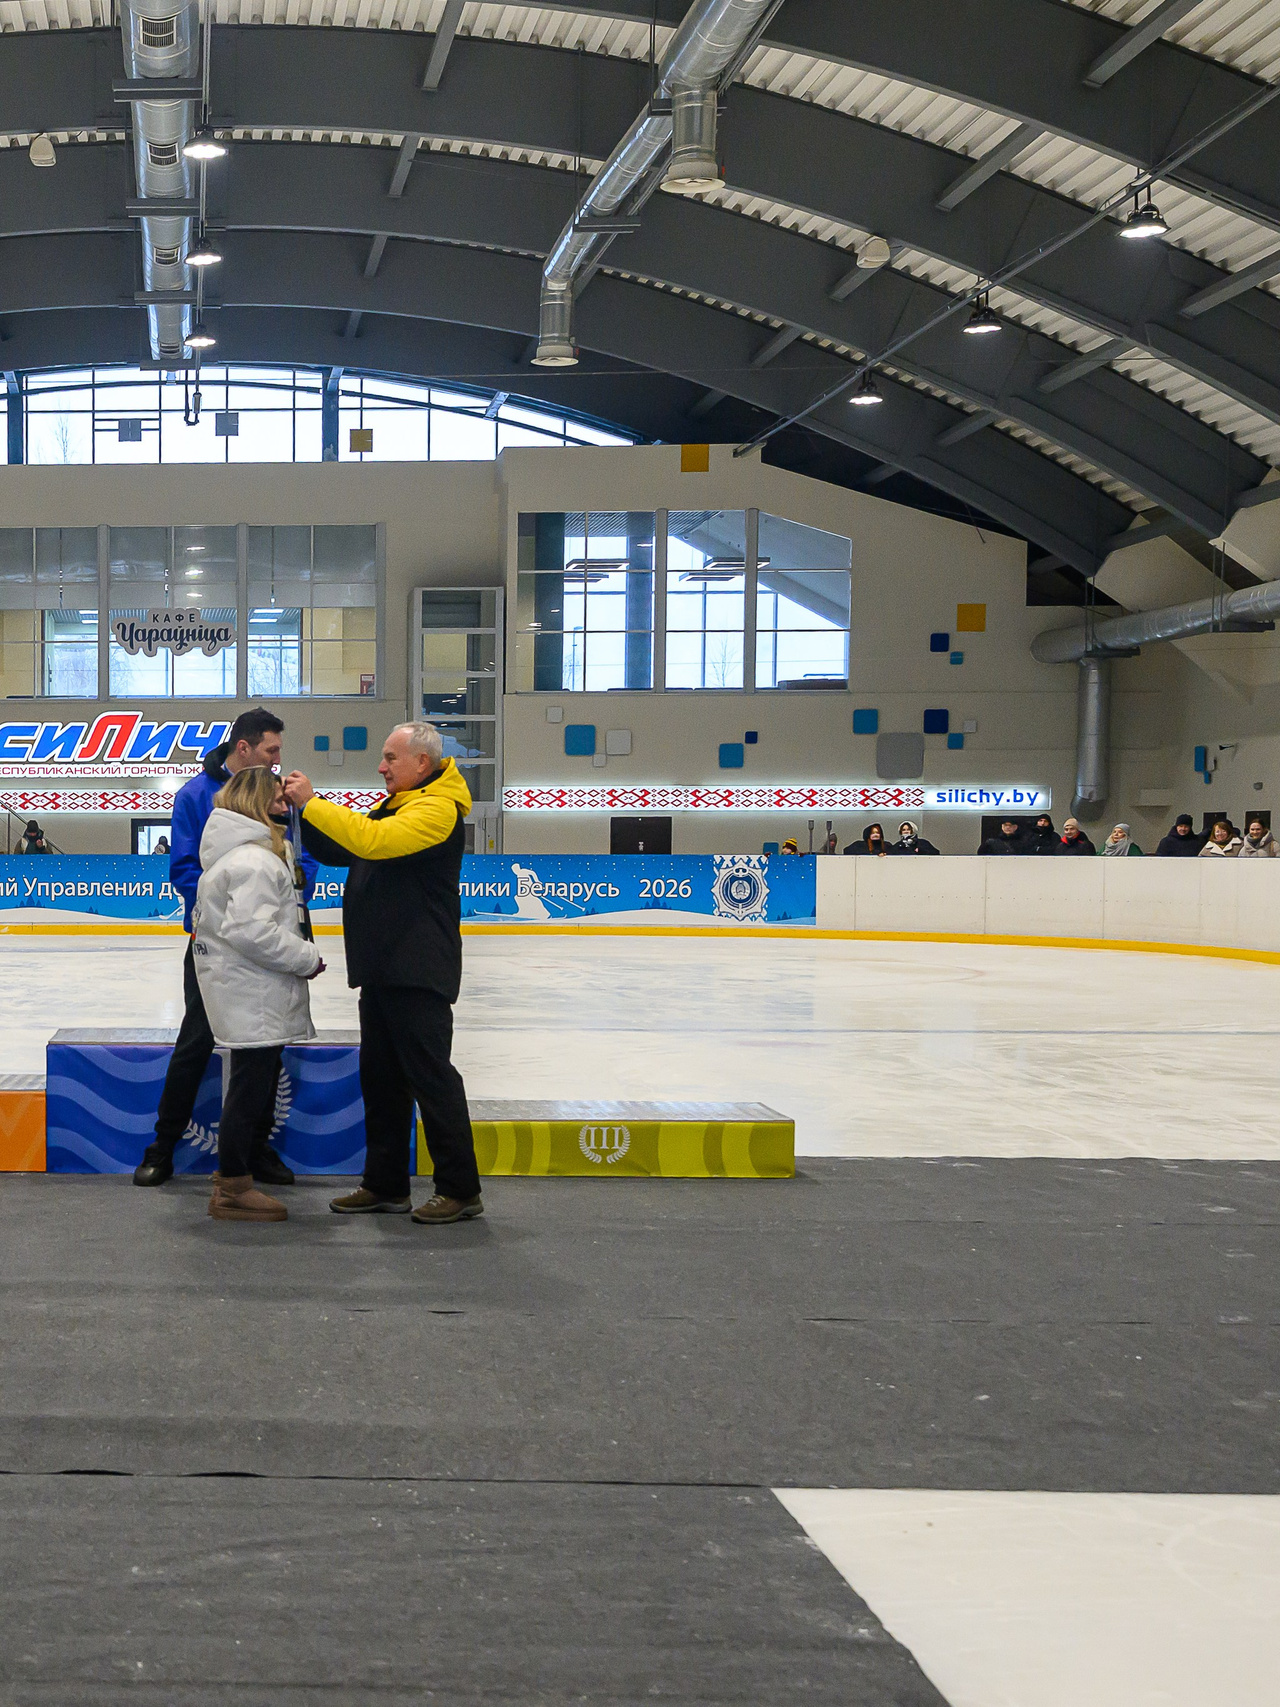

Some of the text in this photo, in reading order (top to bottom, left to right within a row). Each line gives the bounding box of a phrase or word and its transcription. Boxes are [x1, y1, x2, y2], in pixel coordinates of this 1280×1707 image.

[152, 613, 195, 623] КАФЕ
[116, 622, 232, 652] Чараўніца
[124, 765, 205, 775] ГОРНОЛЫЖ
[936, 789, 1039, 806] silichy.by
[22, 877, 153, 901] Управления
[516, 878, 621, 902] Беларусь
[637, 878, 693, 899] 2026
[587, 1126, 622, 1150] III
